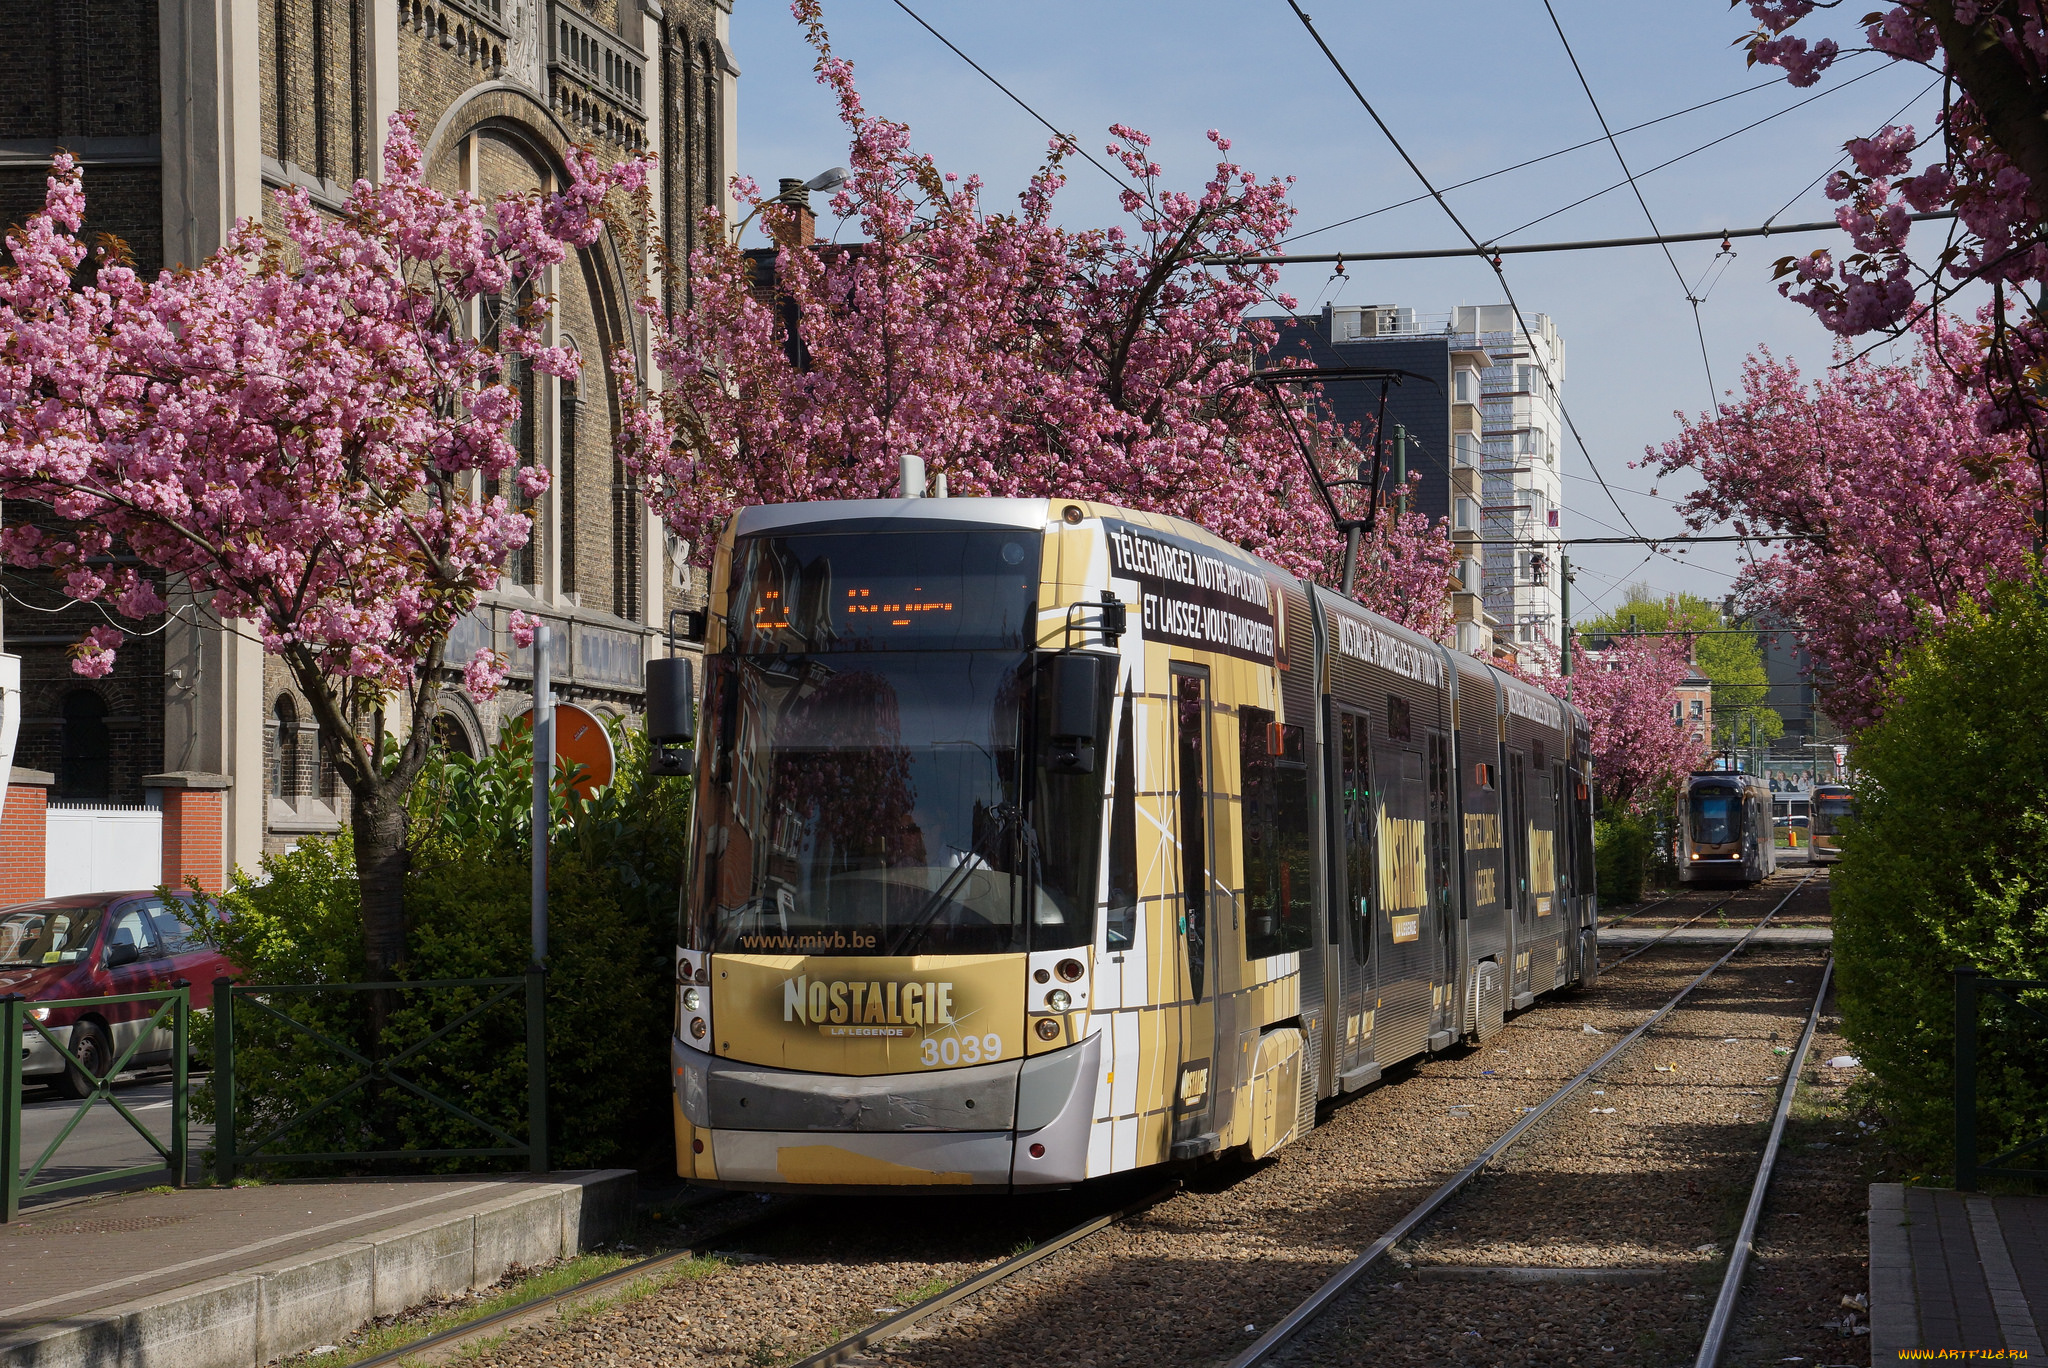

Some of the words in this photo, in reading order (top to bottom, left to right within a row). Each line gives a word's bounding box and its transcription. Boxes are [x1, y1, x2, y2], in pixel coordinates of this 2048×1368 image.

[1110, 525, 1196, 586] TÉLÉCHARGEZ
[1194, 554, 1228, 594] NOTRE
[1226, 564, 1269, 609] APPLICATION
[1143, 592, 1158, 630] ET
[1160, 596, 1229, 645] LAISSEZ-VOUS
[1227, 613, 1275, 658] TRANSPORTER
[1336, 613, 1374, 664] NOSTALGIE
[1378, 801, 1429, 923] NOSTALGIE
[741, 931, 877, 949] www.mivb.be
[783, 973, 954, 1028] NOSTALGIE
[848, 1028, 904, 1037] LEGENDE
[919, 1033, 1002, 1067] 3039
